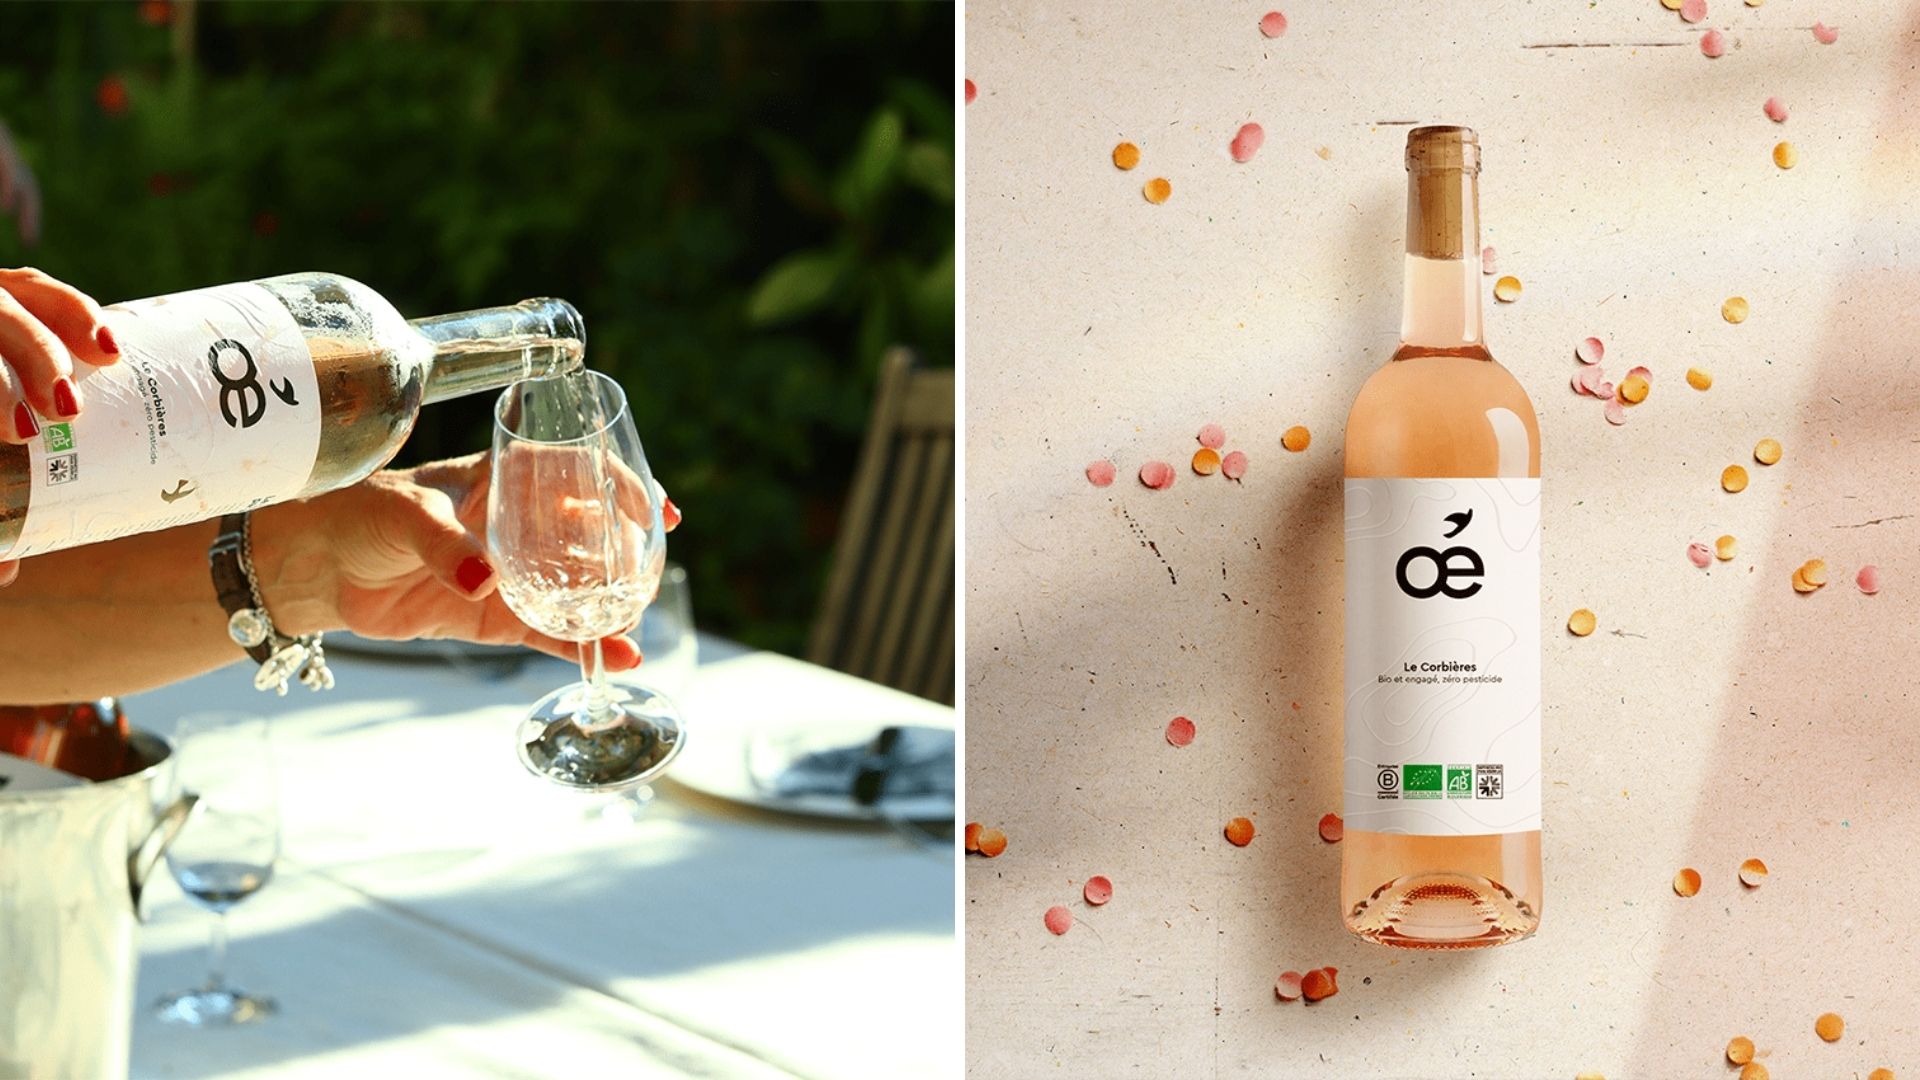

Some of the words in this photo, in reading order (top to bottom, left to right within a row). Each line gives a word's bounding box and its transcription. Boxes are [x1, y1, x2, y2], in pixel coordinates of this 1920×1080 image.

[148, 378, 166, 436] Corbières
[148, 424, 158, 465] pesticide
[1403, 662, 1417, 672] Le
[1420, 661, 1477, 672] Corbières
[1378, 675, 1392, 683] Bio
[1394, 675, 1403, 683] et
[1405, 675, 1440, 684] engagé,
[1442, 675, 1460, 683] zéro
[1463, 675, 1502, 684] pesticide
[1449, 776, 1469, 790] AB
